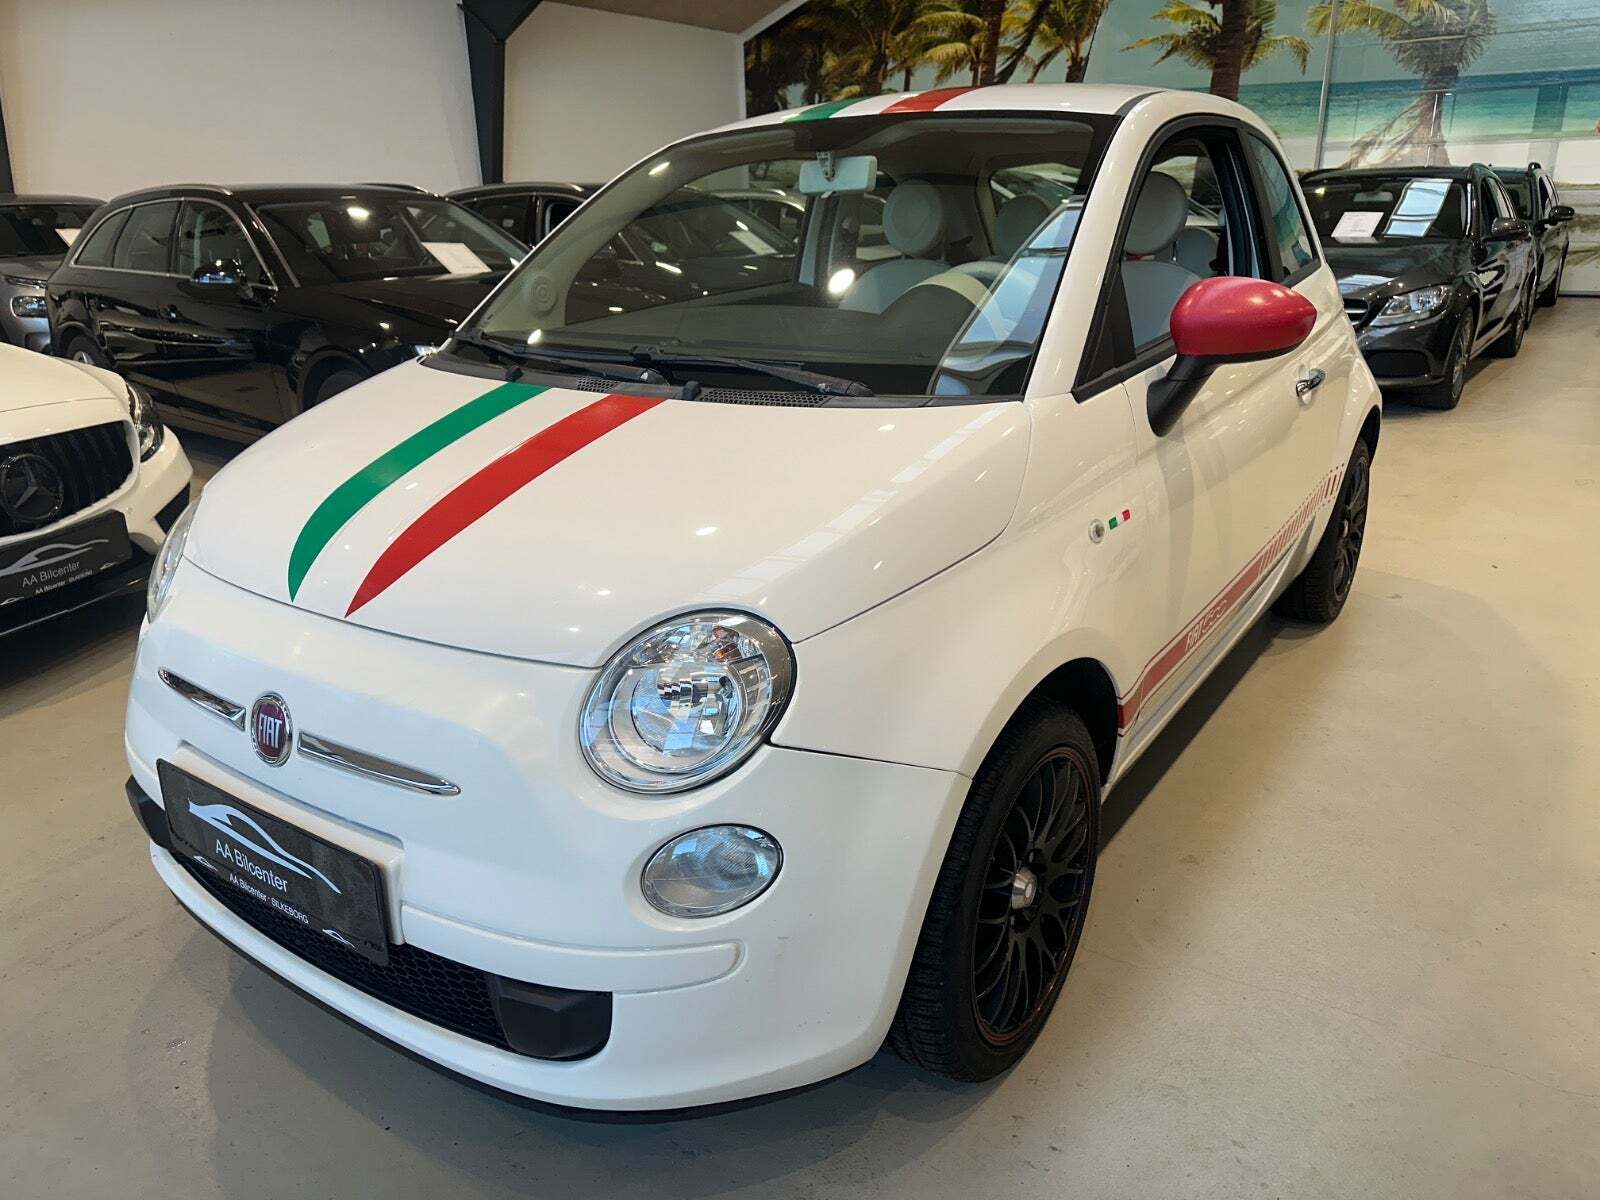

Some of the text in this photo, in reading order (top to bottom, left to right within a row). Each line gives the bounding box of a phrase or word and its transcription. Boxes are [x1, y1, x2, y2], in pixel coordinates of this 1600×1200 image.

[22, 574, 38, 588] AA
[40, 561, 80, 582] Bilcenter
[258, 713, 283, 749] FIAT
[215, 839, 288, 892] AA Bilcenter
[229, 873, 239, 886] AA
[239, 879, 267, 902] Bilcenter
